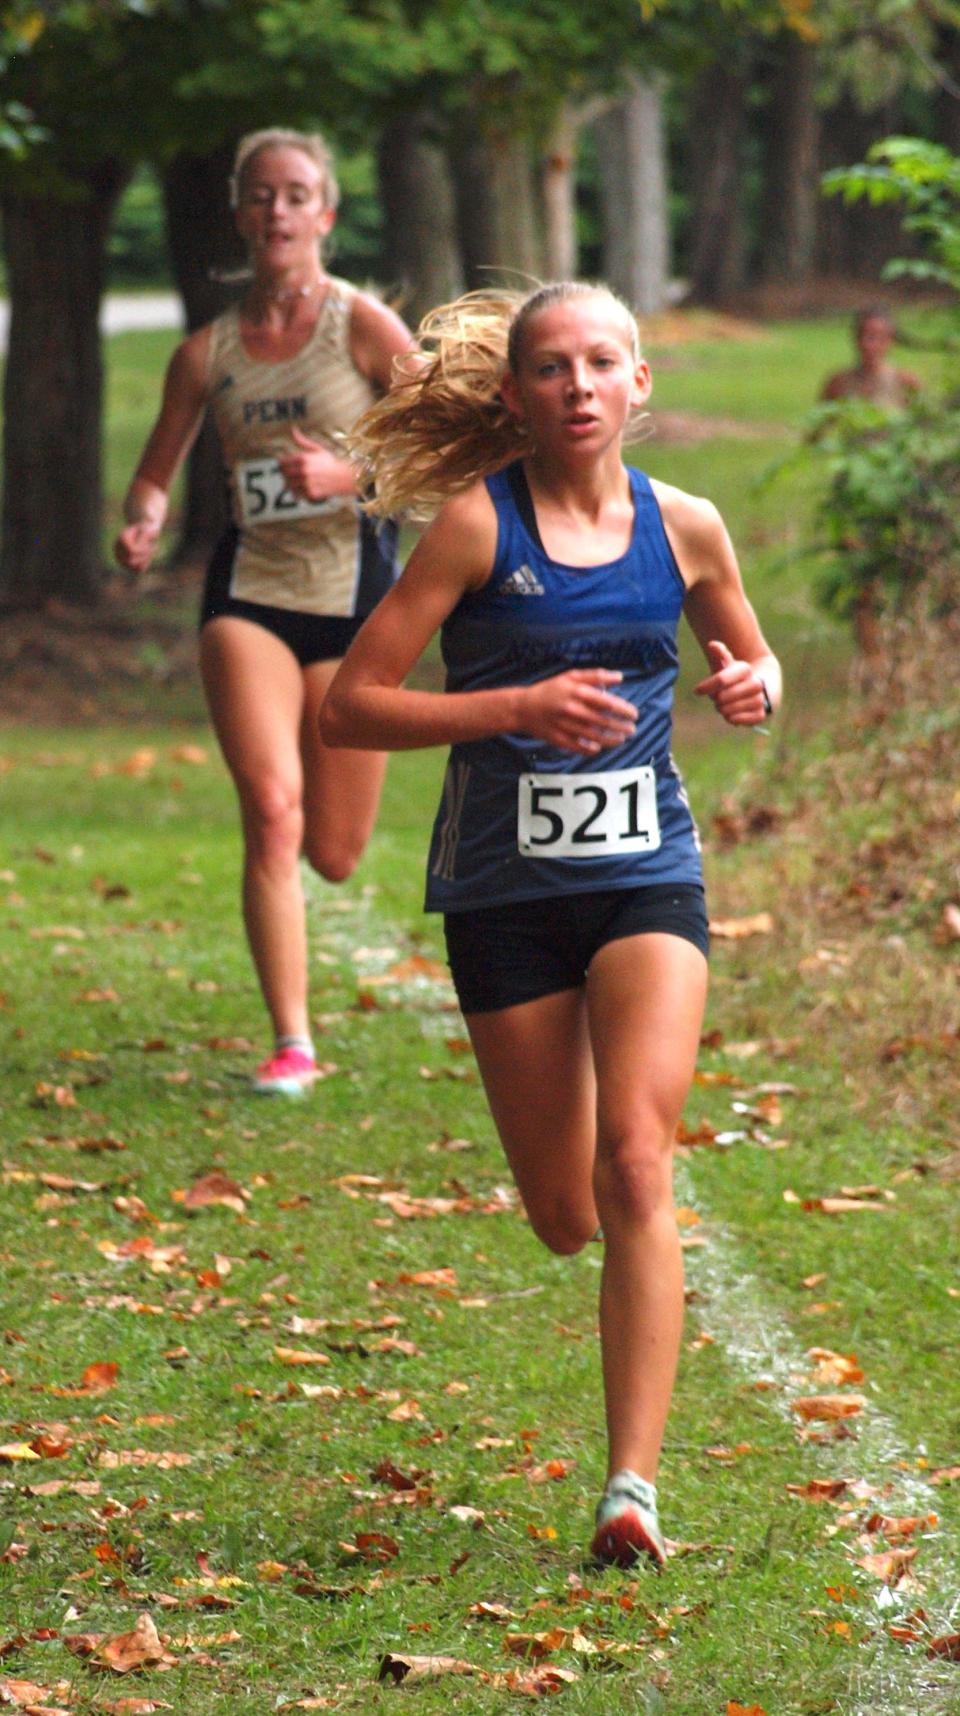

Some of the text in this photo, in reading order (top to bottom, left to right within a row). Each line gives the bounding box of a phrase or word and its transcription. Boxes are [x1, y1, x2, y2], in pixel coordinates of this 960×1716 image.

[243, 397, 308, 423] PENN
[245, 467, 330, 516] 52
[499, 581, 545, 597] adidas
[529, 780, 649, 846] 521
